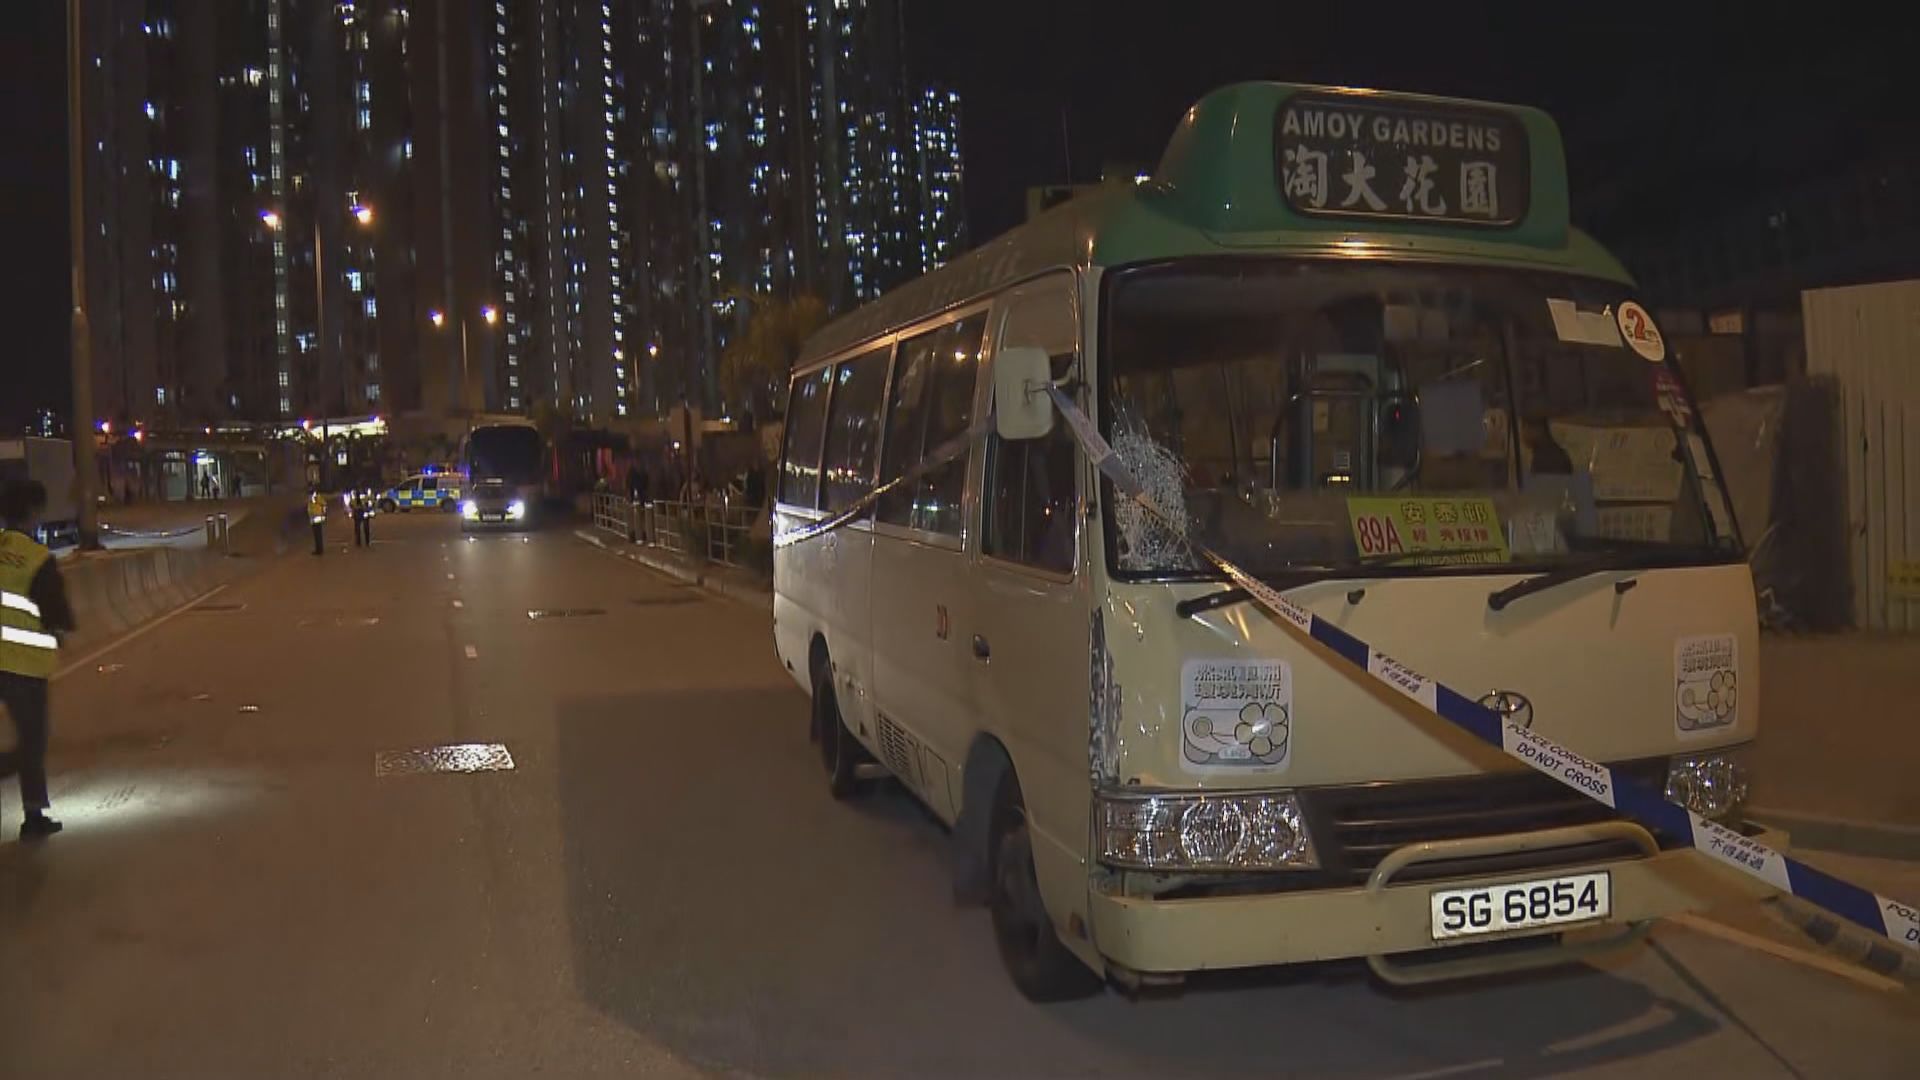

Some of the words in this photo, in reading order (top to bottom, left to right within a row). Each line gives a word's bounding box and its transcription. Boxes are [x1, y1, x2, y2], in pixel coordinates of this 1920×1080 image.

[1282, 109, 1364, 139] AMOY
[1373, 117, 1500, 150] GARDENS
[1283, 144, 1499, 219] 淘大花園
[1357, 516, 1404, 554] 89A
[1516, 742, 1536, 757] DO
[1535, 752, 1563, 771] NOT
[1564, 767, 1608, 795] CROSS
[1442, 892, 1492, 931] SG
[1504, 880, 1599, 923] 6854
